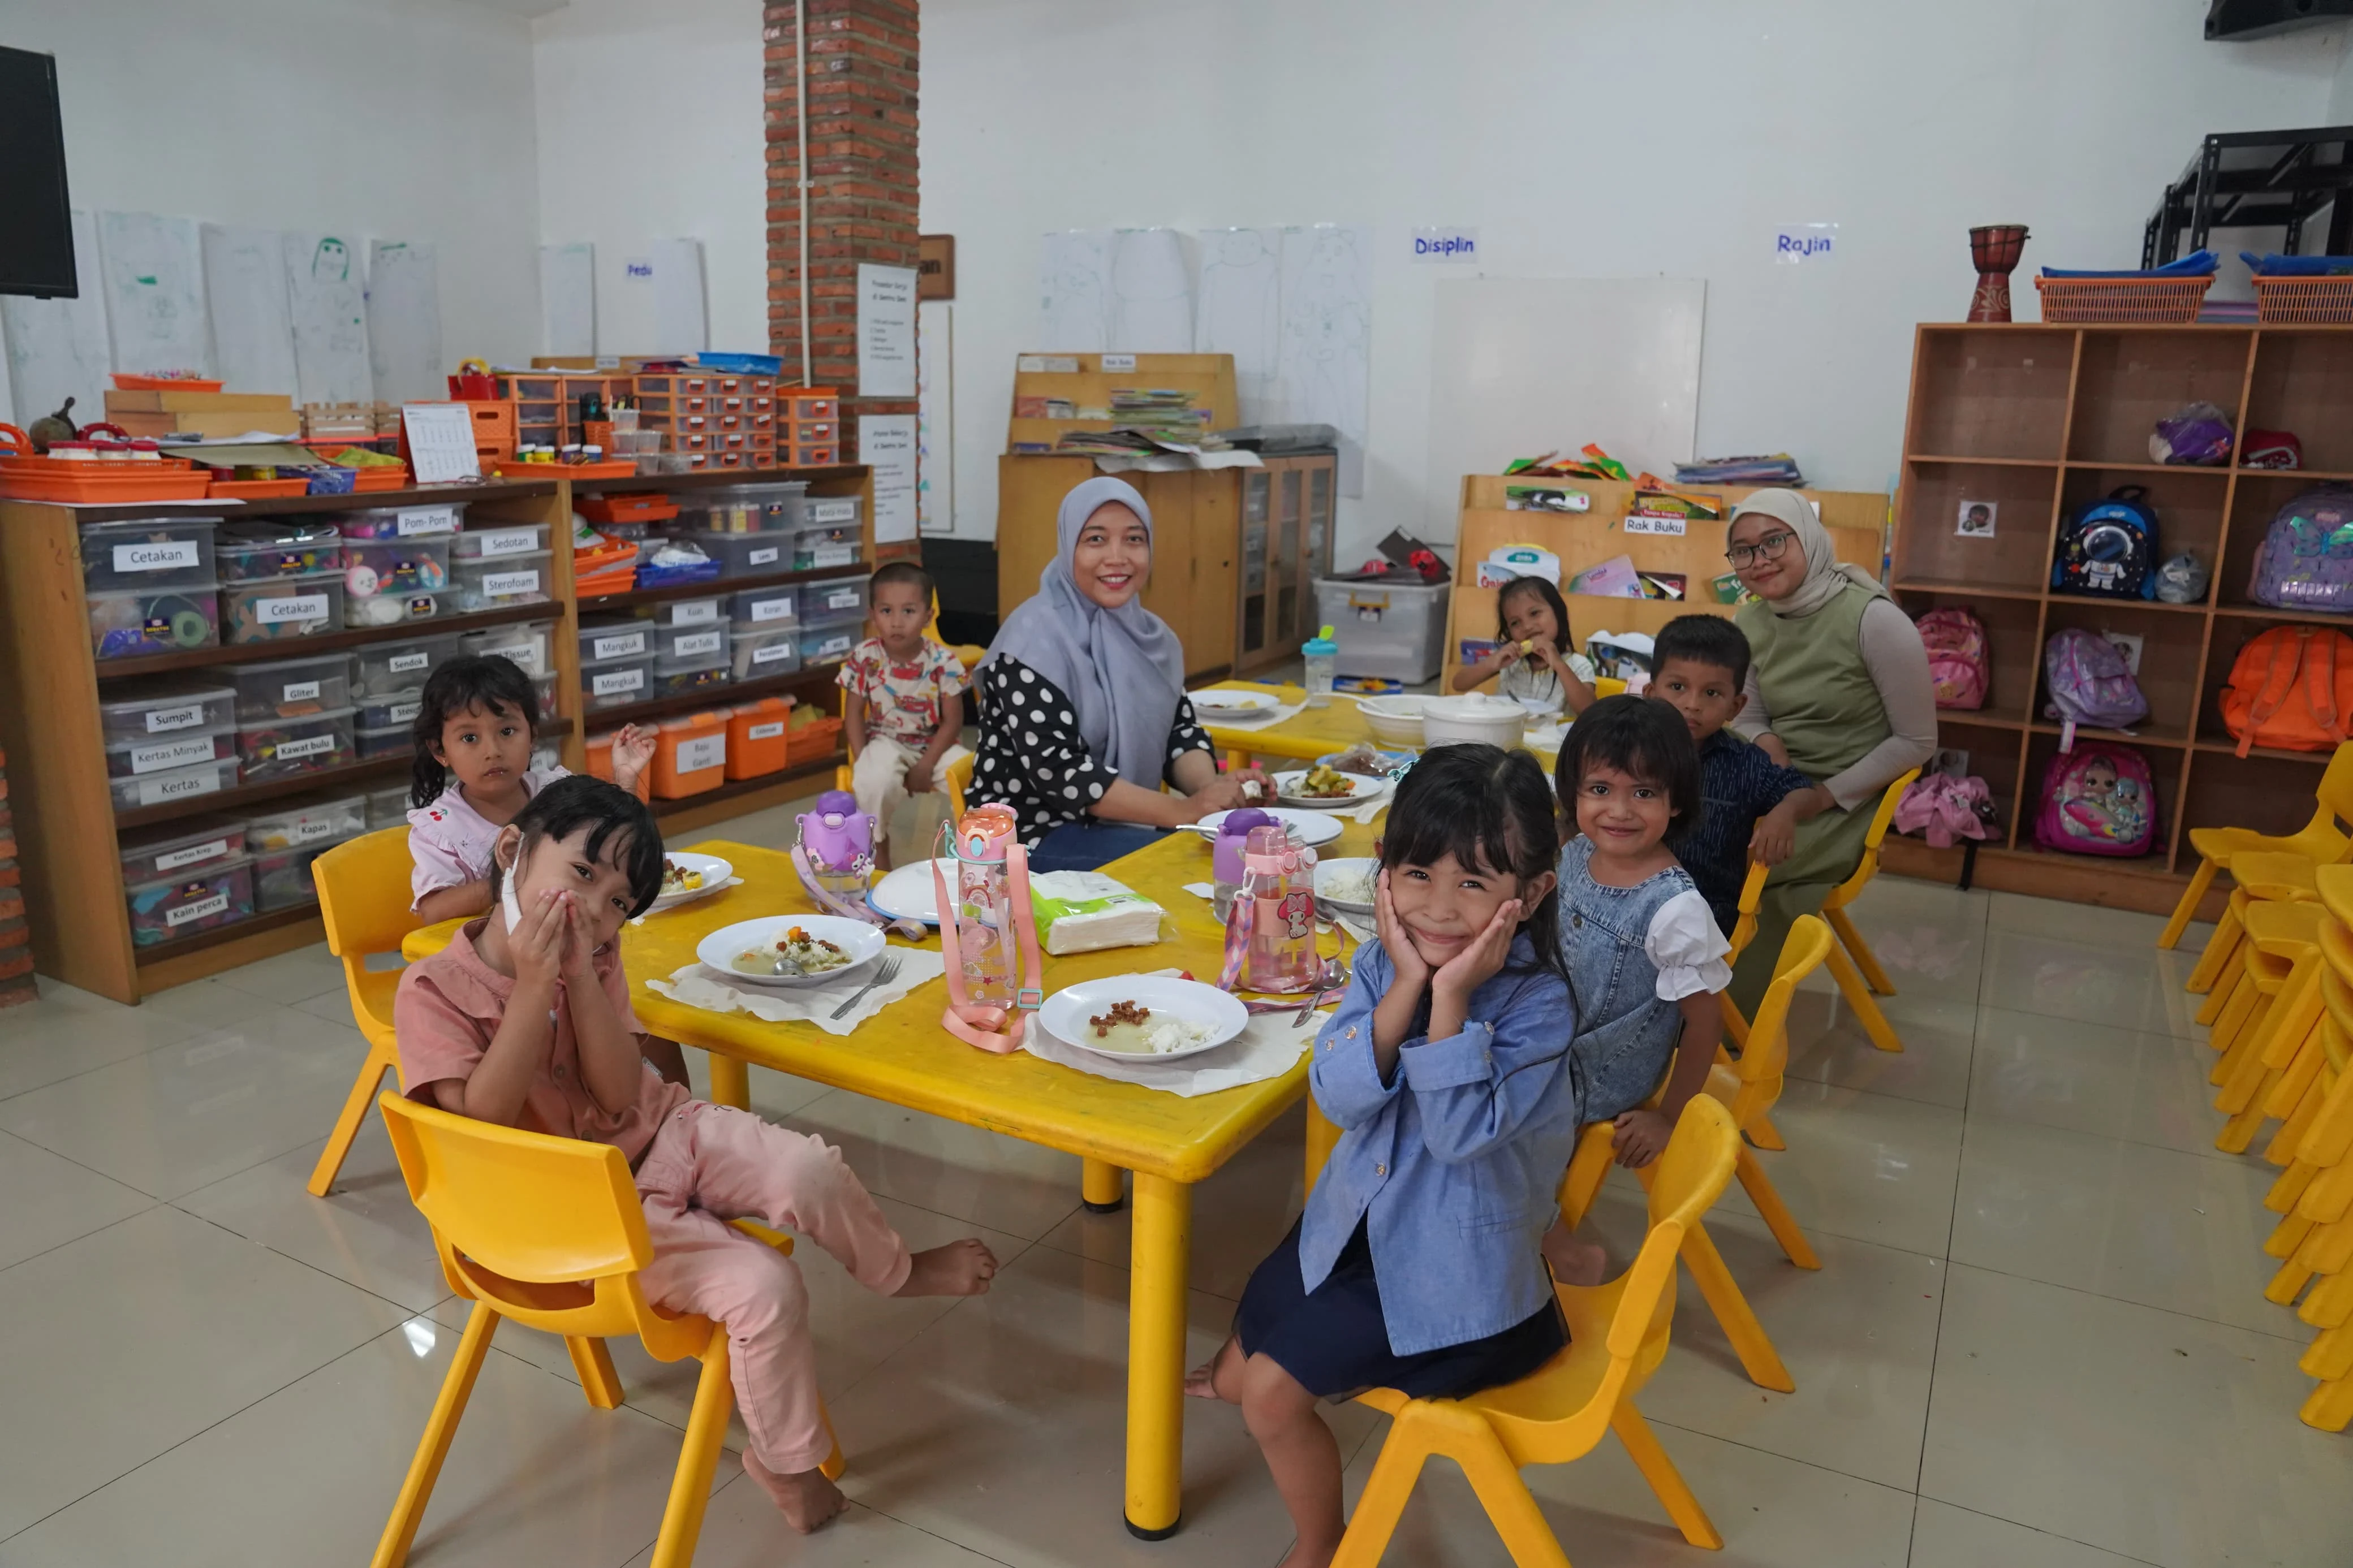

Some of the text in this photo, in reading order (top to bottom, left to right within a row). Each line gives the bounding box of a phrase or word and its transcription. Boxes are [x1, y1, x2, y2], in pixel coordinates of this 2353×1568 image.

[1415, 236, 1474, 256] Disiplin
[1777, 234, 1830, 256] Rajin
[428, 515, 447, 526] Pom
[1627, 519, 1682, 533] Rak Buku
[492, 537, 528, 549] Sedotan
[130, 548, 183, 564] Cetakan
[488, 577, 535, 591] Sterofoam
[271, 602, 316, 616] Cetakan
[602, 640, 638, 652] Mangkuk
[394, 658, 424, 669] Sendok
[601, 675, 637, 689] Mangkuk
[290, 688, 314, 699] Gliter
[155, 710, 193, 727] Sumpit
[137, 742, 209, 763] Kertas Minyak
[281, 738, 330, 756] Kawat bulu
[161, 777, 200, 794] Kertas
[301, 823, 327, 836] Kapas
[173, 850, 195, 862] Kertas
[173, 897, 222, 919] Kain perca
